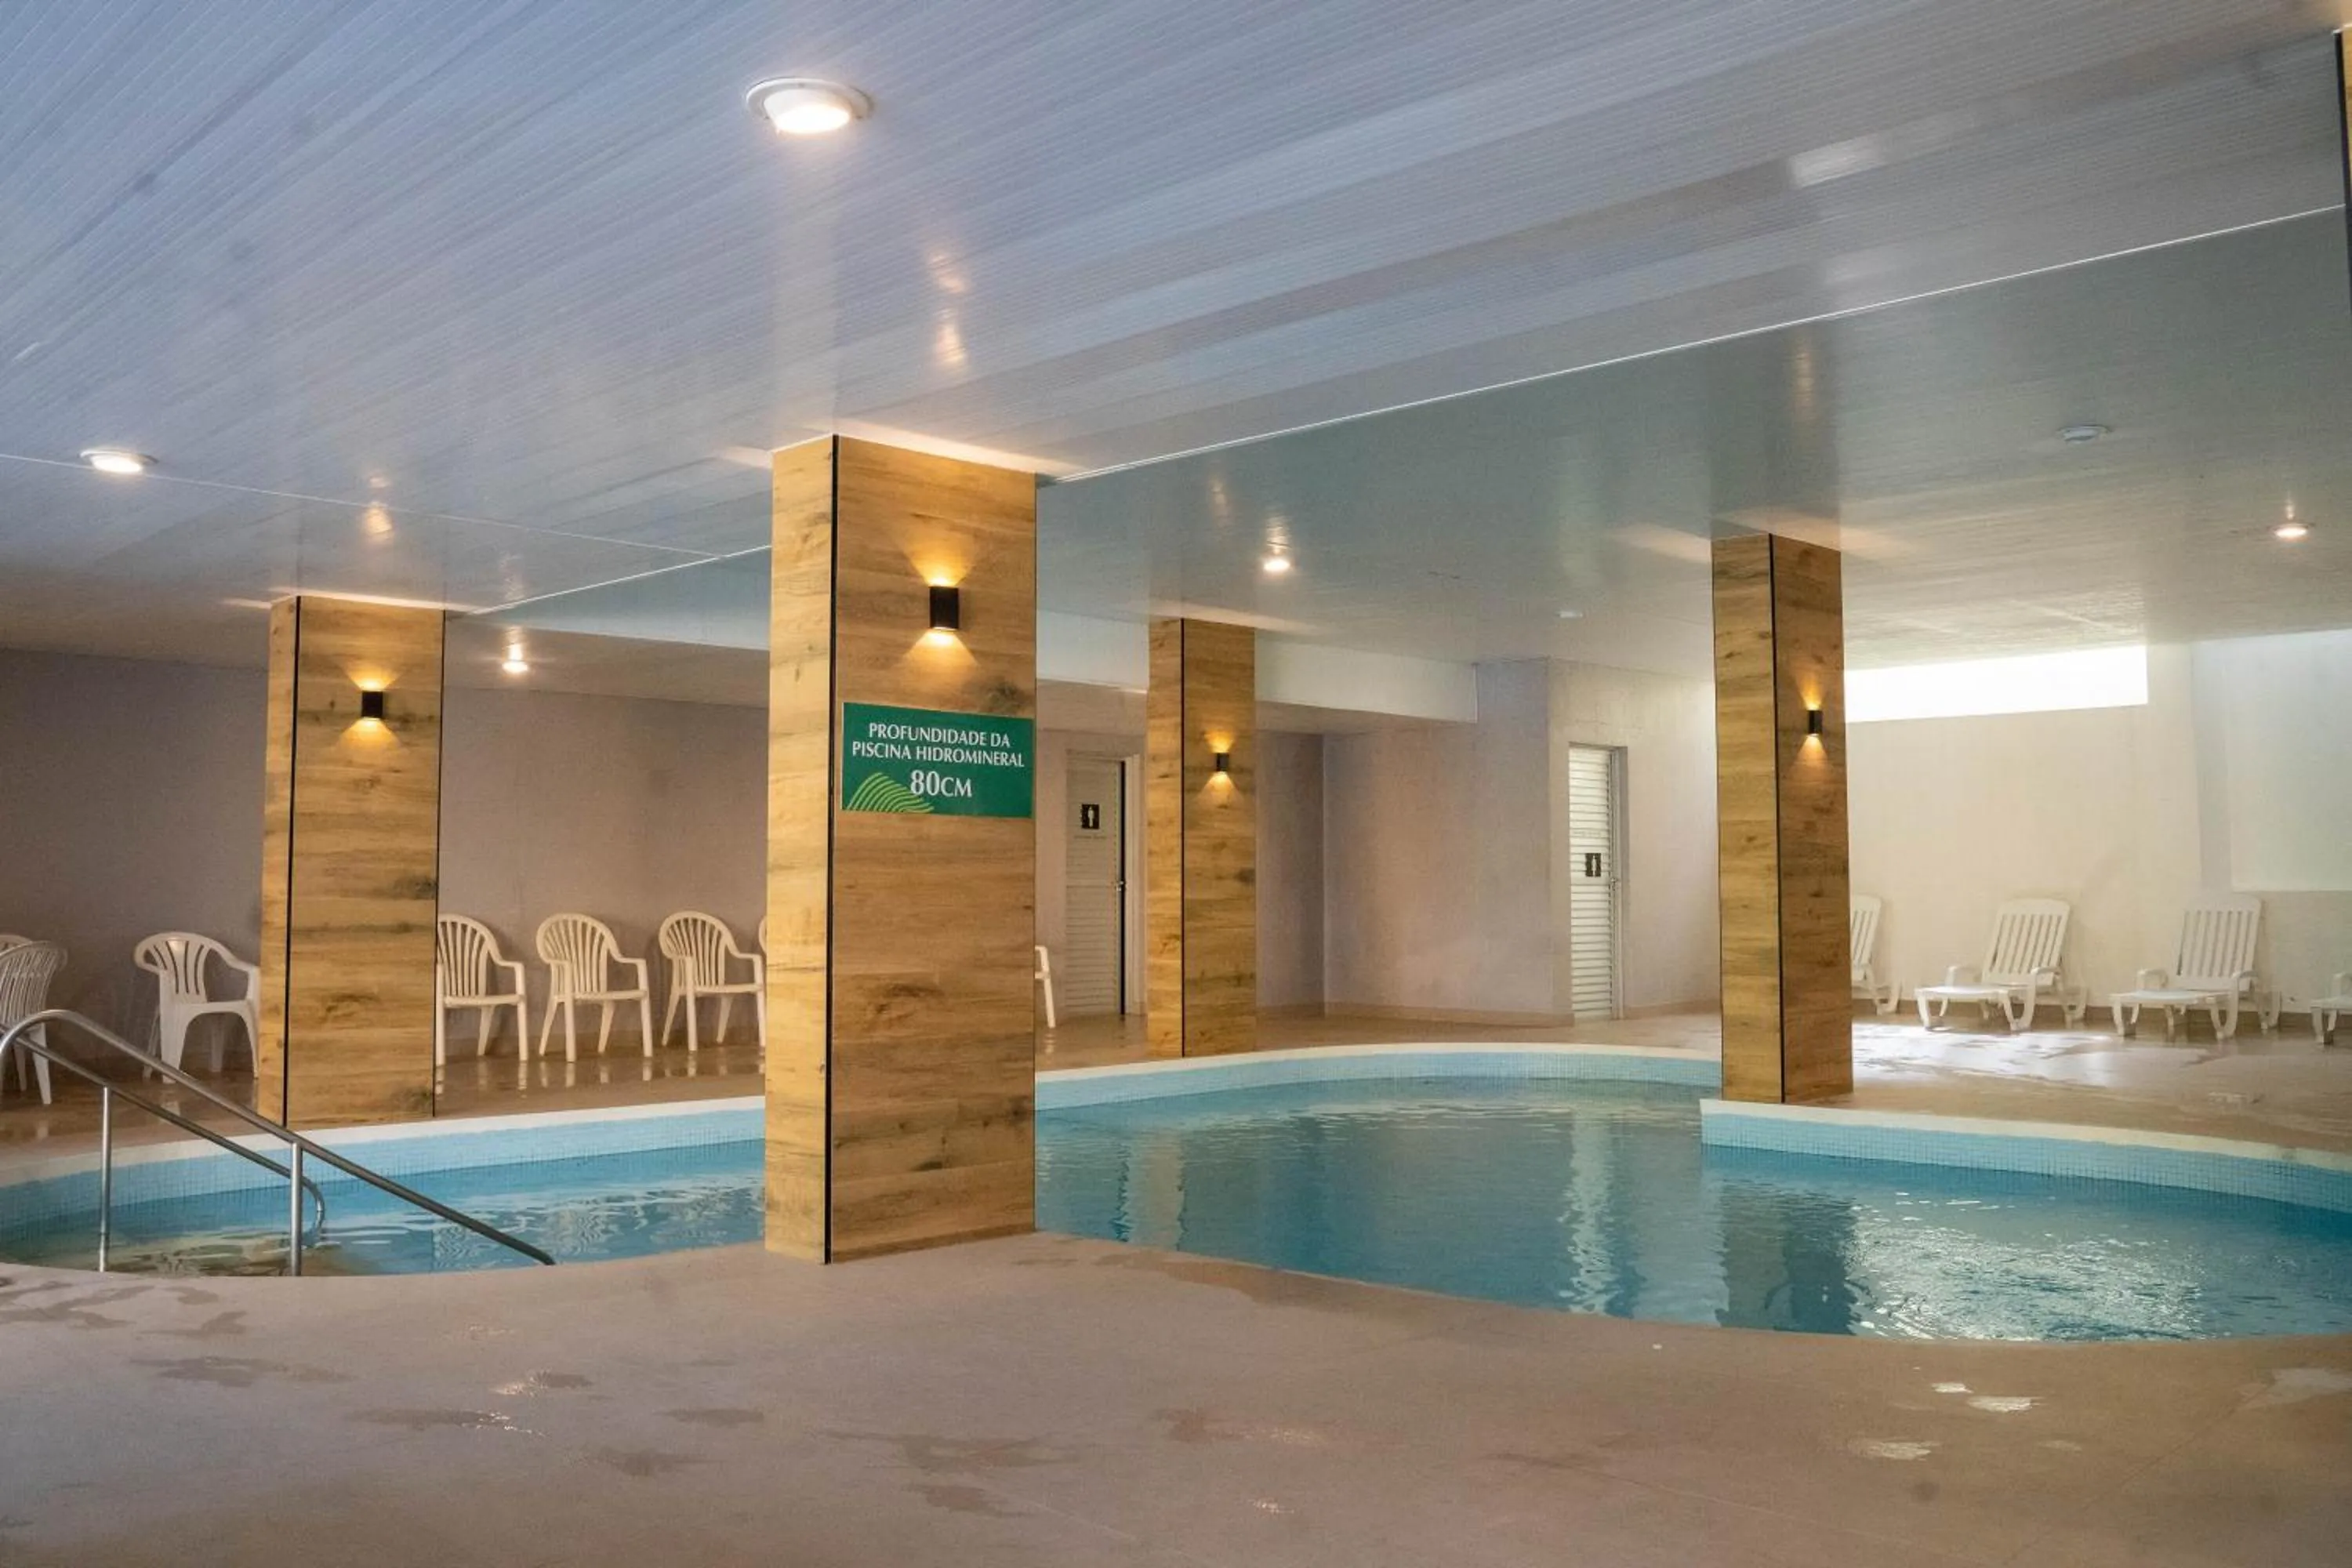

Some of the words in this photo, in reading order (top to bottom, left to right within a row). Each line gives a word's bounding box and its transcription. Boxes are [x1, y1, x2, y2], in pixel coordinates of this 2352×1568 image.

[869, 722, 987, 746] PROFUNDIDADE
[990, 733, 1011, 749] DA
[852, 741, 912, 760] PISCINA
[916, 747, 1025, 768] HIDROMINERAL
